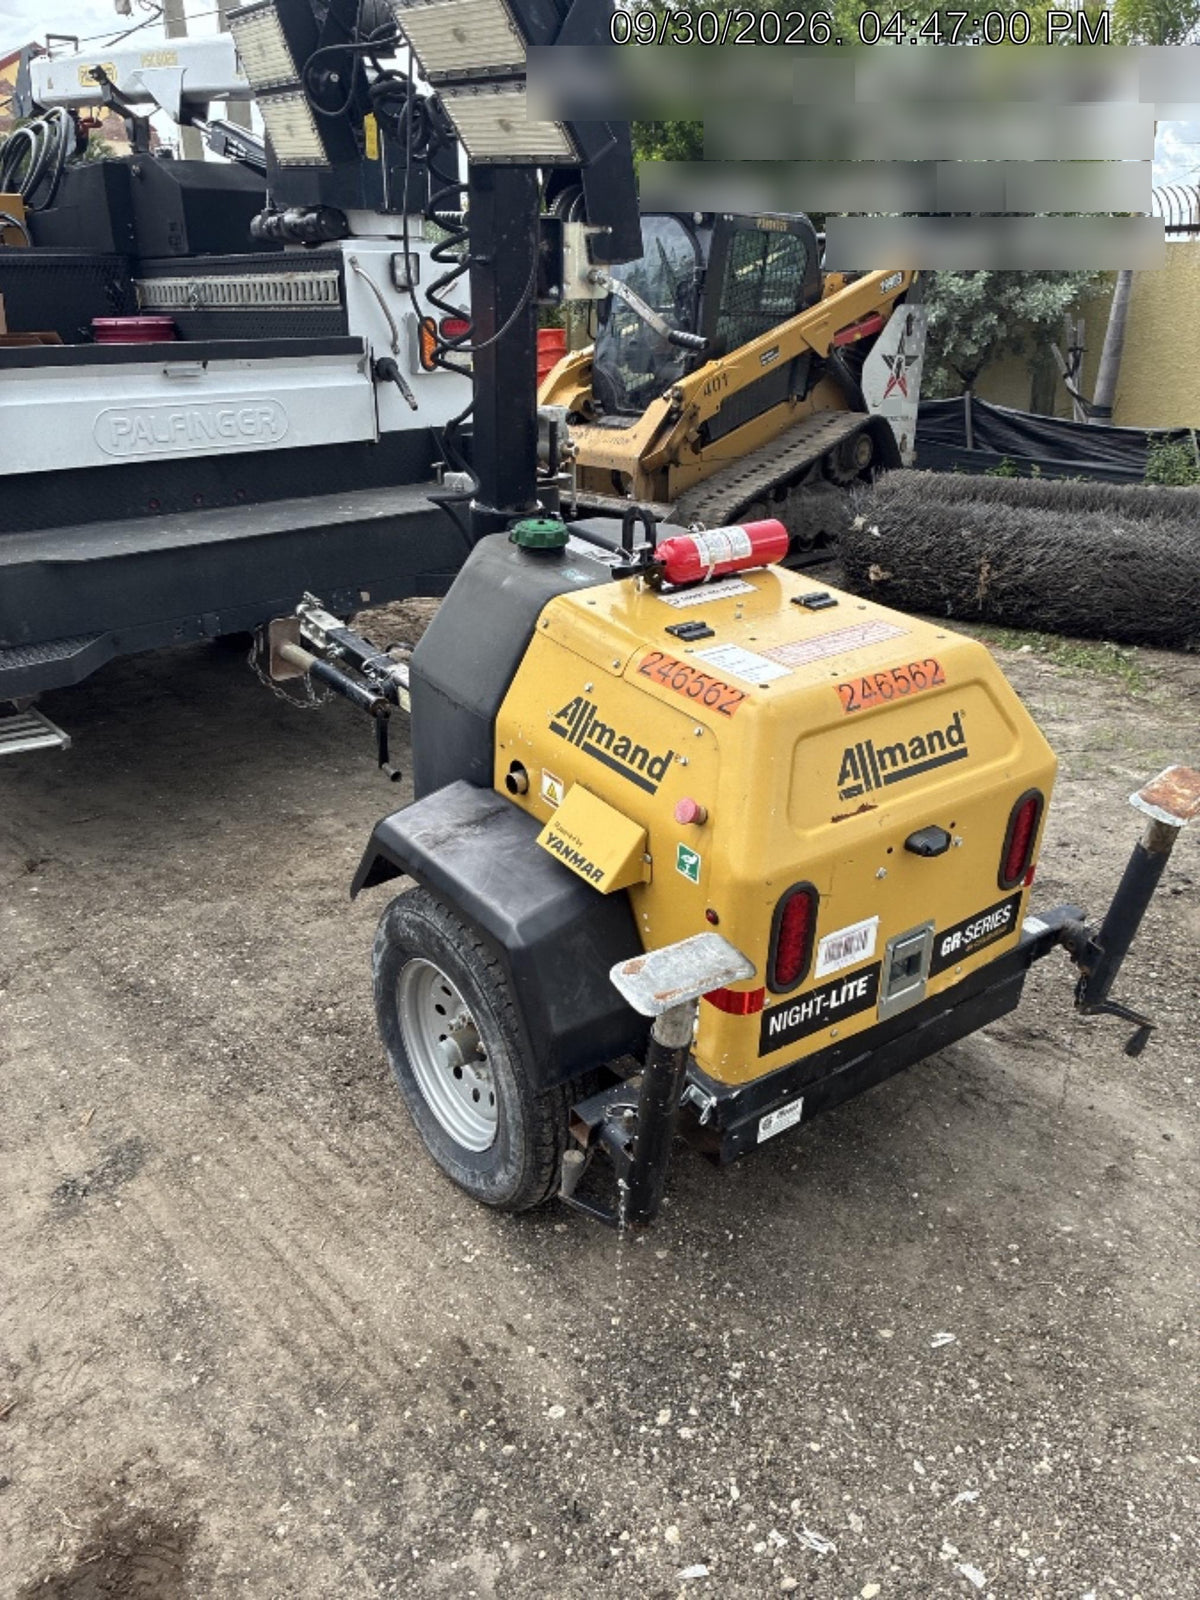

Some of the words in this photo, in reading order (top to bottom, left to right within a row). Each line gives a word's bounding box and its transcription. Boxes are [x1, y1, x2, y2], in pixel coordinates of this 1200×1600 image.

[703, 373, 729, 397] 401
[110, 407, 277, 447] PALFINGER
[639, 651, 746, 716] 246562
[838, 658, 945, 712] 246562
[553, 696, 675, 783] Allmand
[837, 710, 966, 793] Allmand
[544, 831, 606, 884] YANMAR
[940, 904, 1013, 958] GR-SERIES
[768, 976, 870, 1037] NIGHT-LITE
